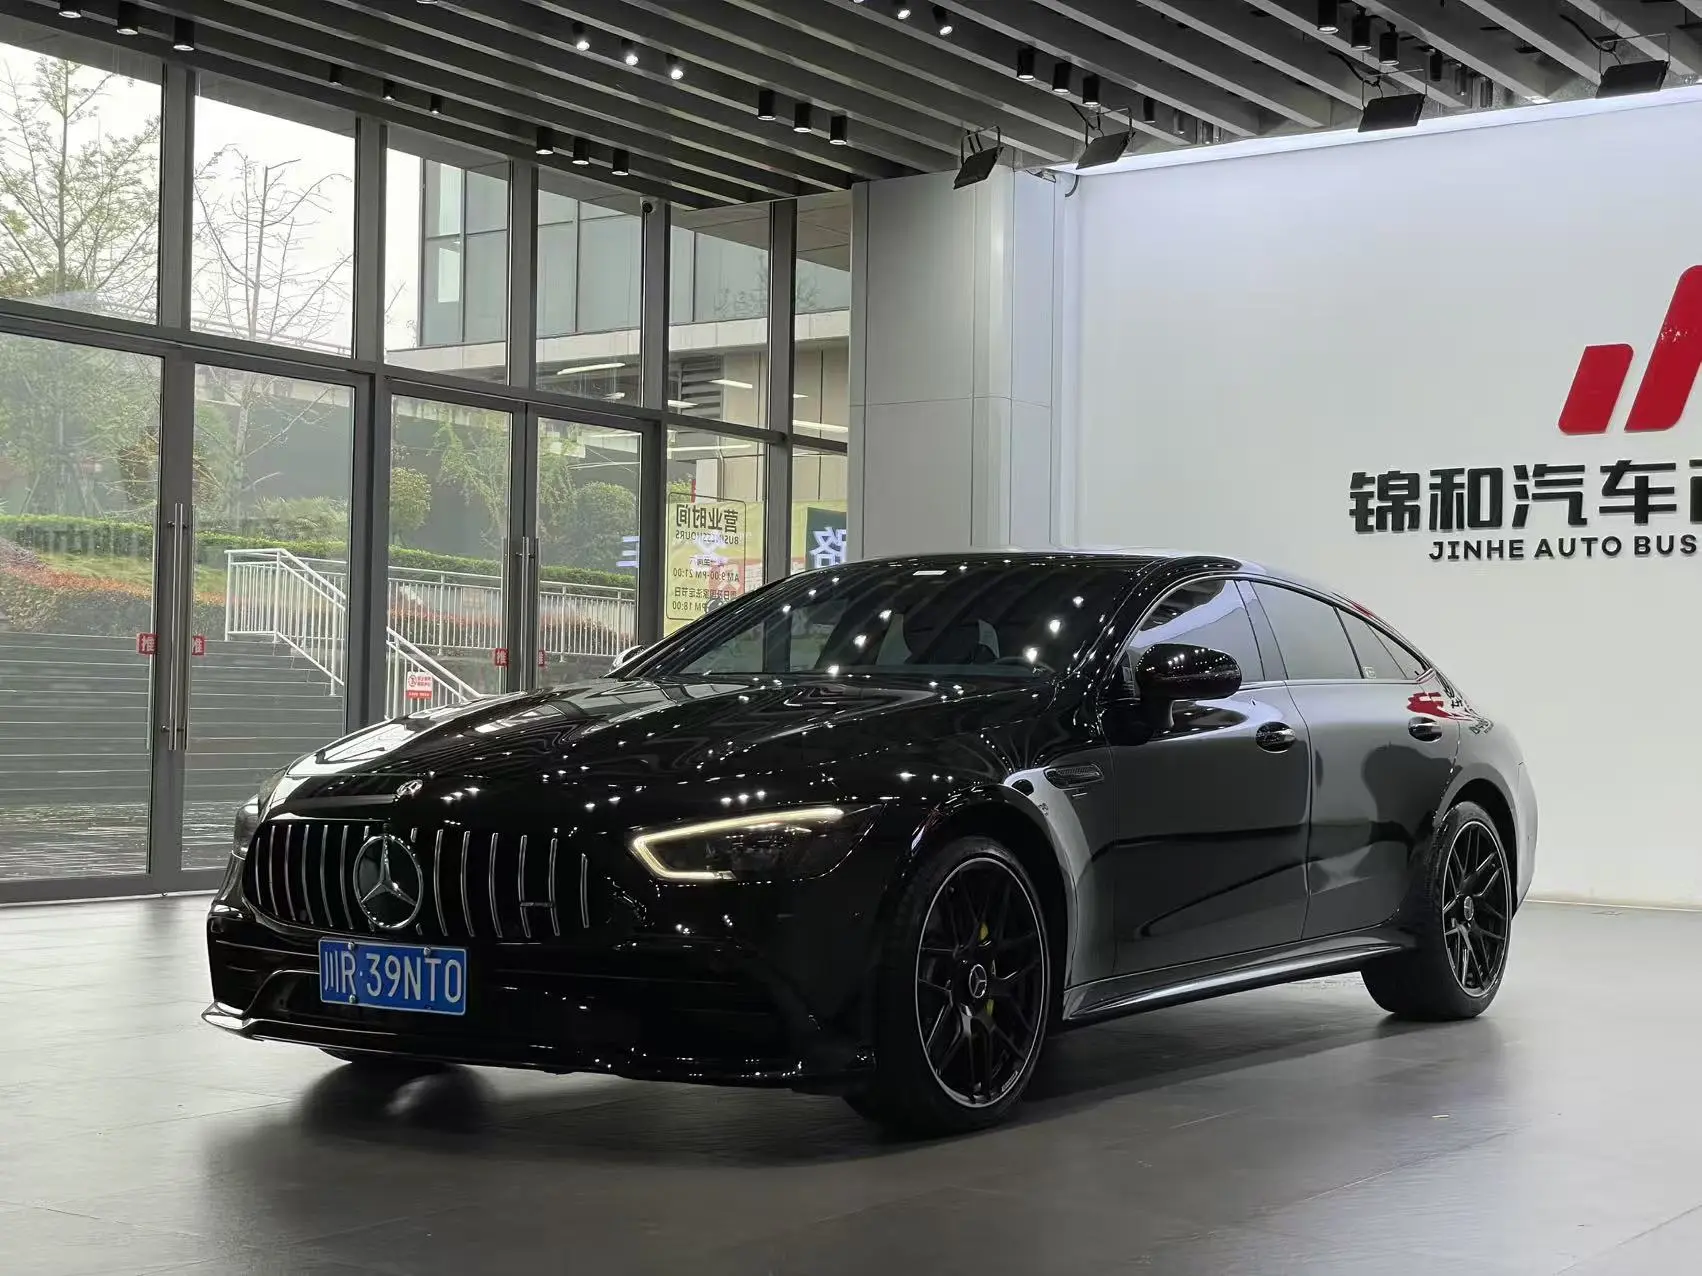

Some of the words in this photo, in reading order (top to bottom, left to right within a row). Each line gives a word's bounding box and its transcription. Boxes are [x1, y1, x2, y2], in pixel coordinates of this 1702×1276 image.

[1349, 459, 1702, 533] 锦和汽车
[1429, 539, 1524, 561] JINHE
[1534, 536, 1622, 559] AUTO
[1634, 534, 1697, 556] BUS
[141, 635, 156, 652] 推
